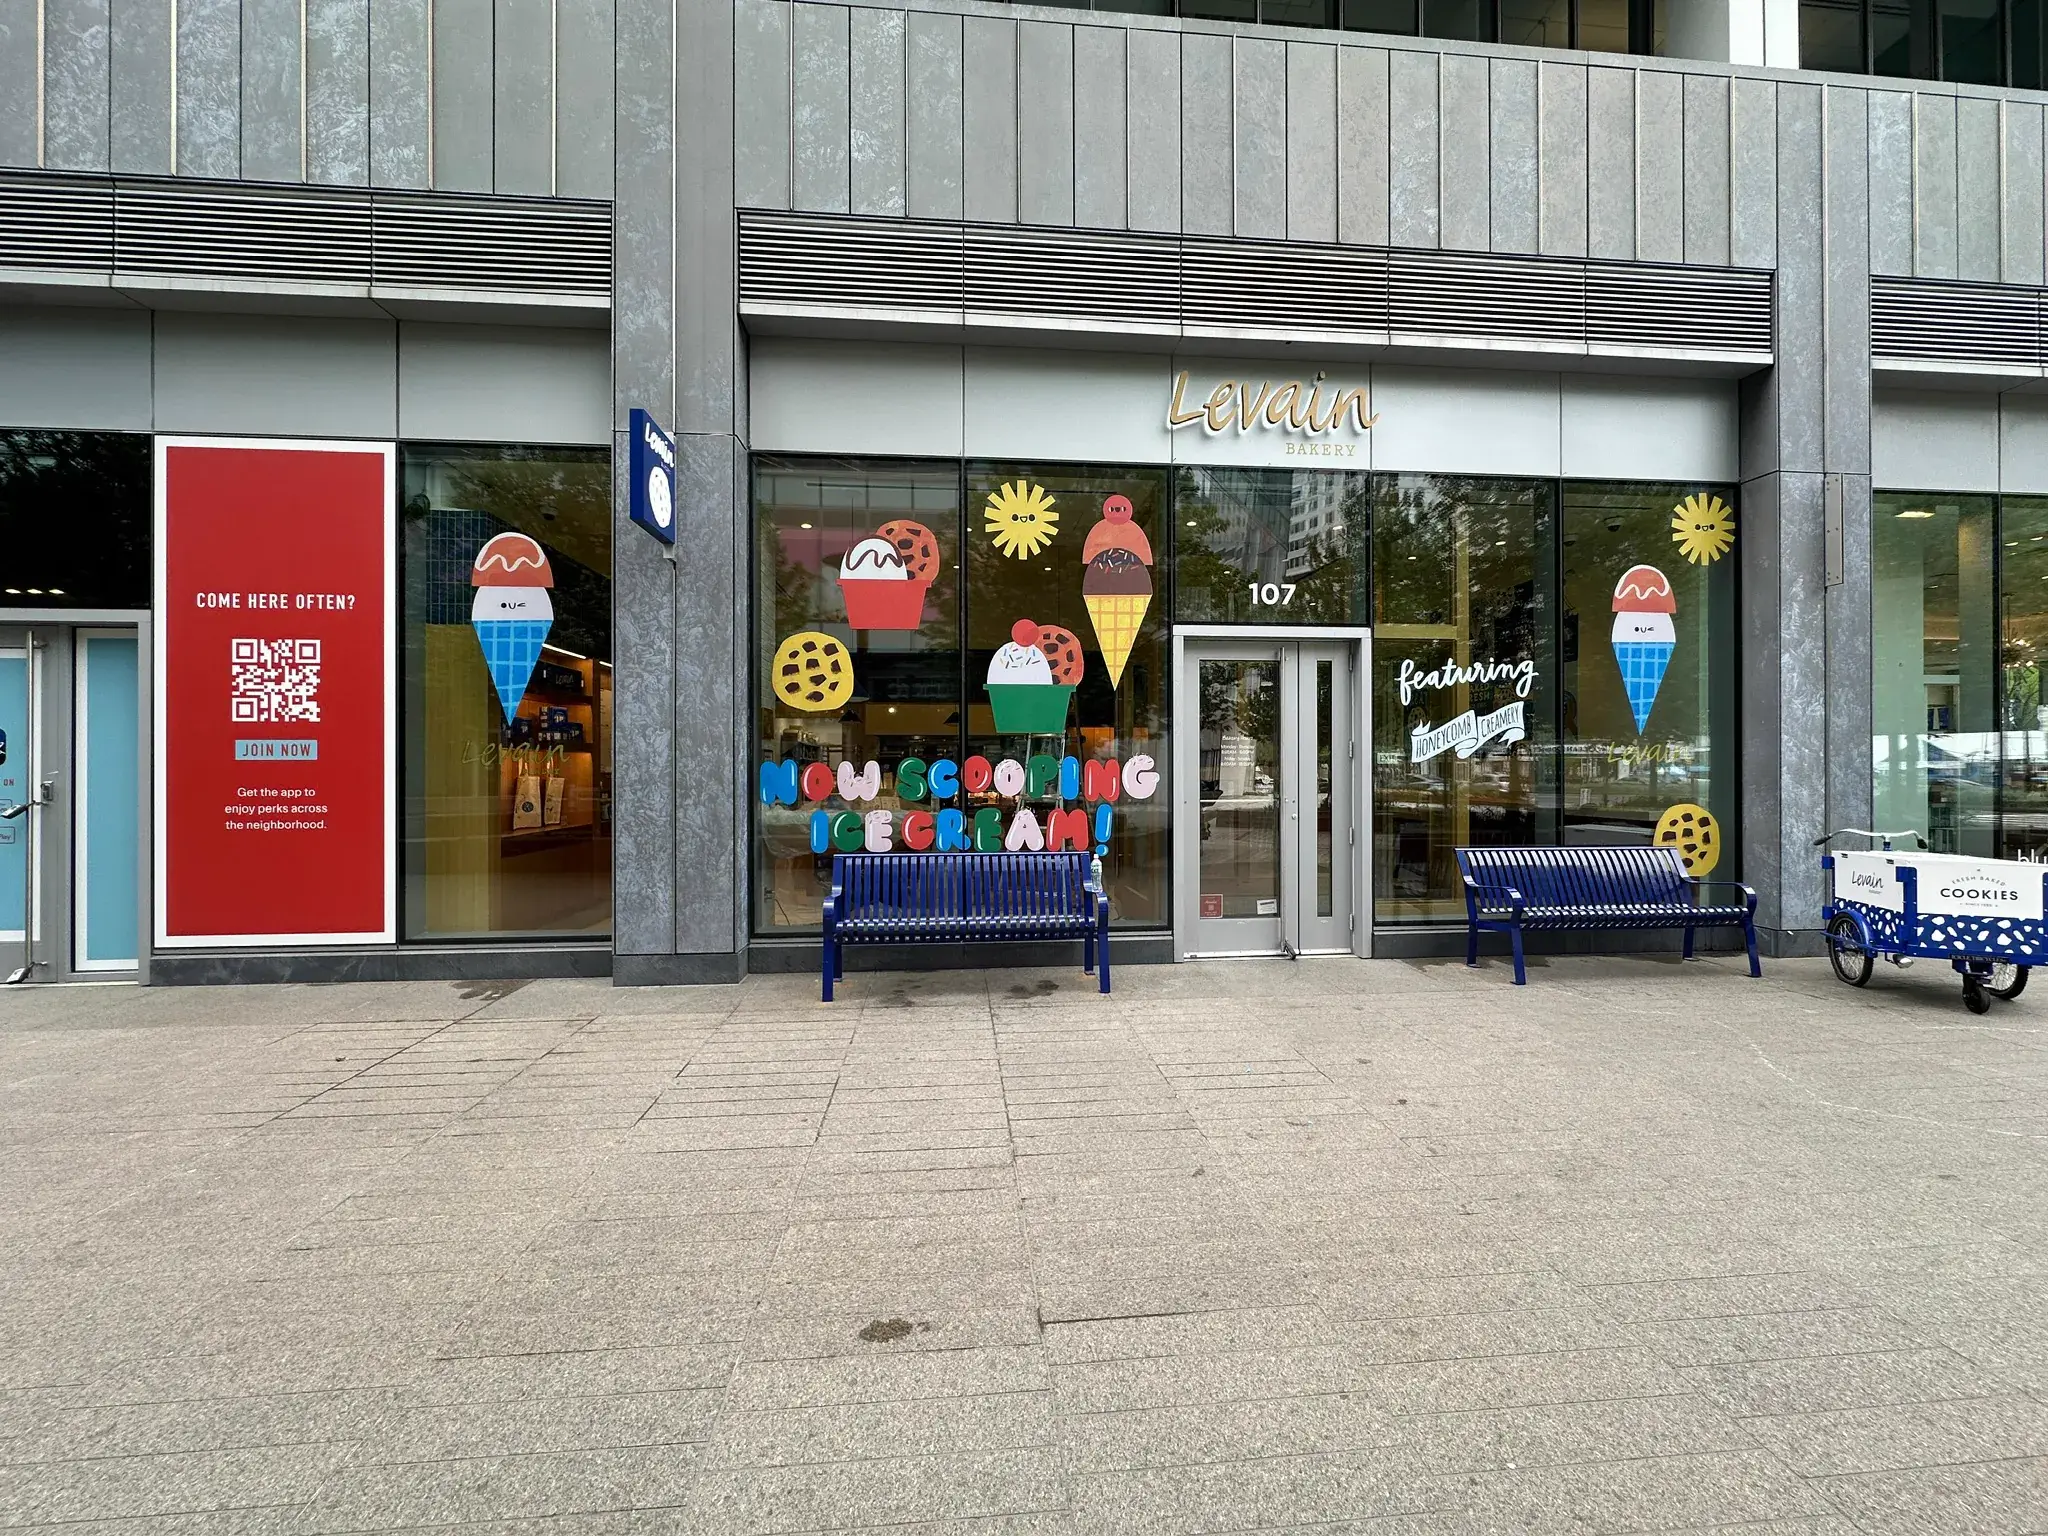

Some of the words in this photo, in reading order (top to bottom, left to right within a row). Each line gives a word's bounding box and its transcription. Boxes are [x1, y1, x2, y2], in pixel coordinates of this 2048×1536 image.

[1169, 370, 1380, 433] Levain
[1285, 442, 1356, 457] BAKERY
[196, 592, 241, 609] COME
[248, 593, 289, 609] HERE
[295, 594, 356, 610] OFTEN?
[1248, 583, 1297, 605] 107
[1394, 656, 1540, 707] featuring
[1415, 714, 1473, 759] HONEYCOMB
[1480, 706, 1521, 738] CREAMERY
[242, 743, 274, 757] JOIN
[281, 743, 311, 757] NOW
[759, 758, 882, 806] NOW
[897, 754, 1161, 803] SCOOPING
[237, 787, 258, 797] Get
[260, 787, 279, 797] the
[280, 789, 302, 799] app
[304, 787, 316, 797] to
[224, 803, 256, 815] enjoy
[257, 803, 289, 815] perks
[290, 804, 328, 814] across
[225, 820, 244, 830] the
[246, 819, 327, 832] neighborhood.
[810, 808, 894, 853] ICE
[902, 803, 1114, 857] CREAM!
[1851, 870, 1885, 889] Levain
[1940, 887, 2019, 901] COOKIES
